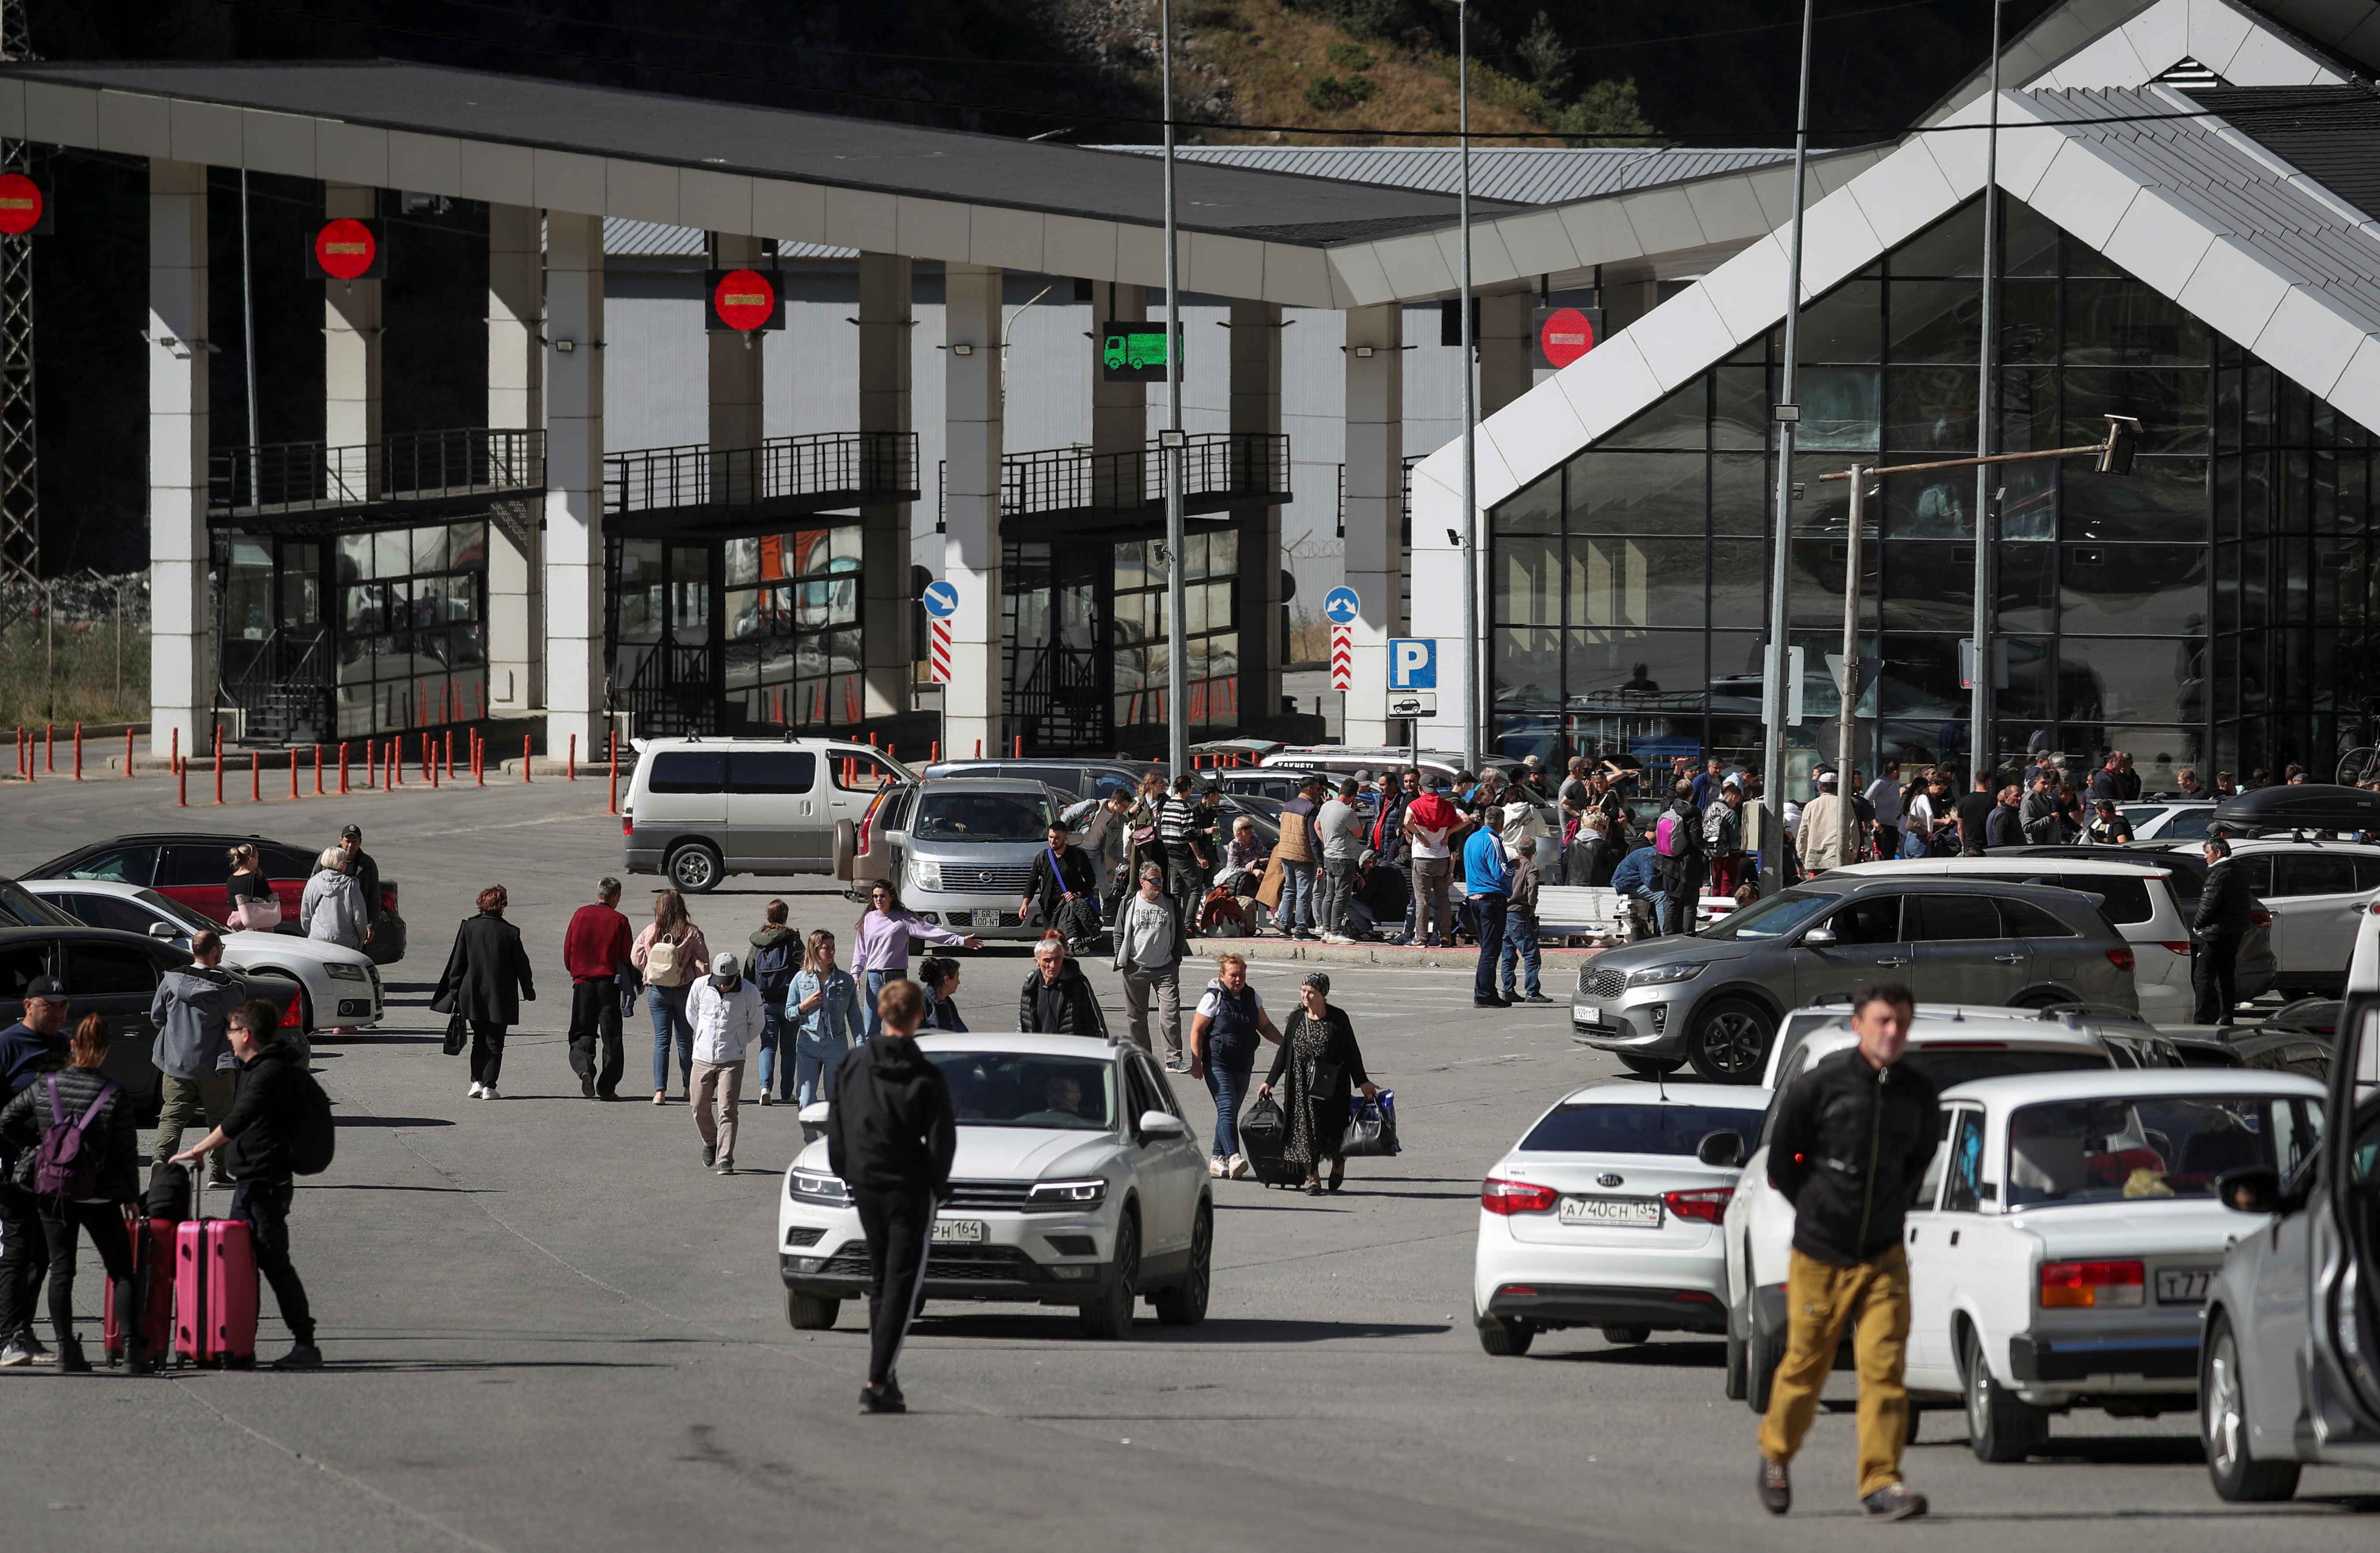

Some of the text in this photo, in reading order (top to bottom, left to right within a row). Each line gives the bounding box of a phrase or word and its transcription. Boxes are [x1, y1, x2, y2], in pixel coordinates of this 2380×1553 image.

[1397, 642, 1429, 685] P
[1135, 909, 1168, 927] 1975
[1601, 1176, 1620, 1185] KIA
[1633, 1202, 1658, 1215] 134
[954, 1222, 978, 1234] 164
